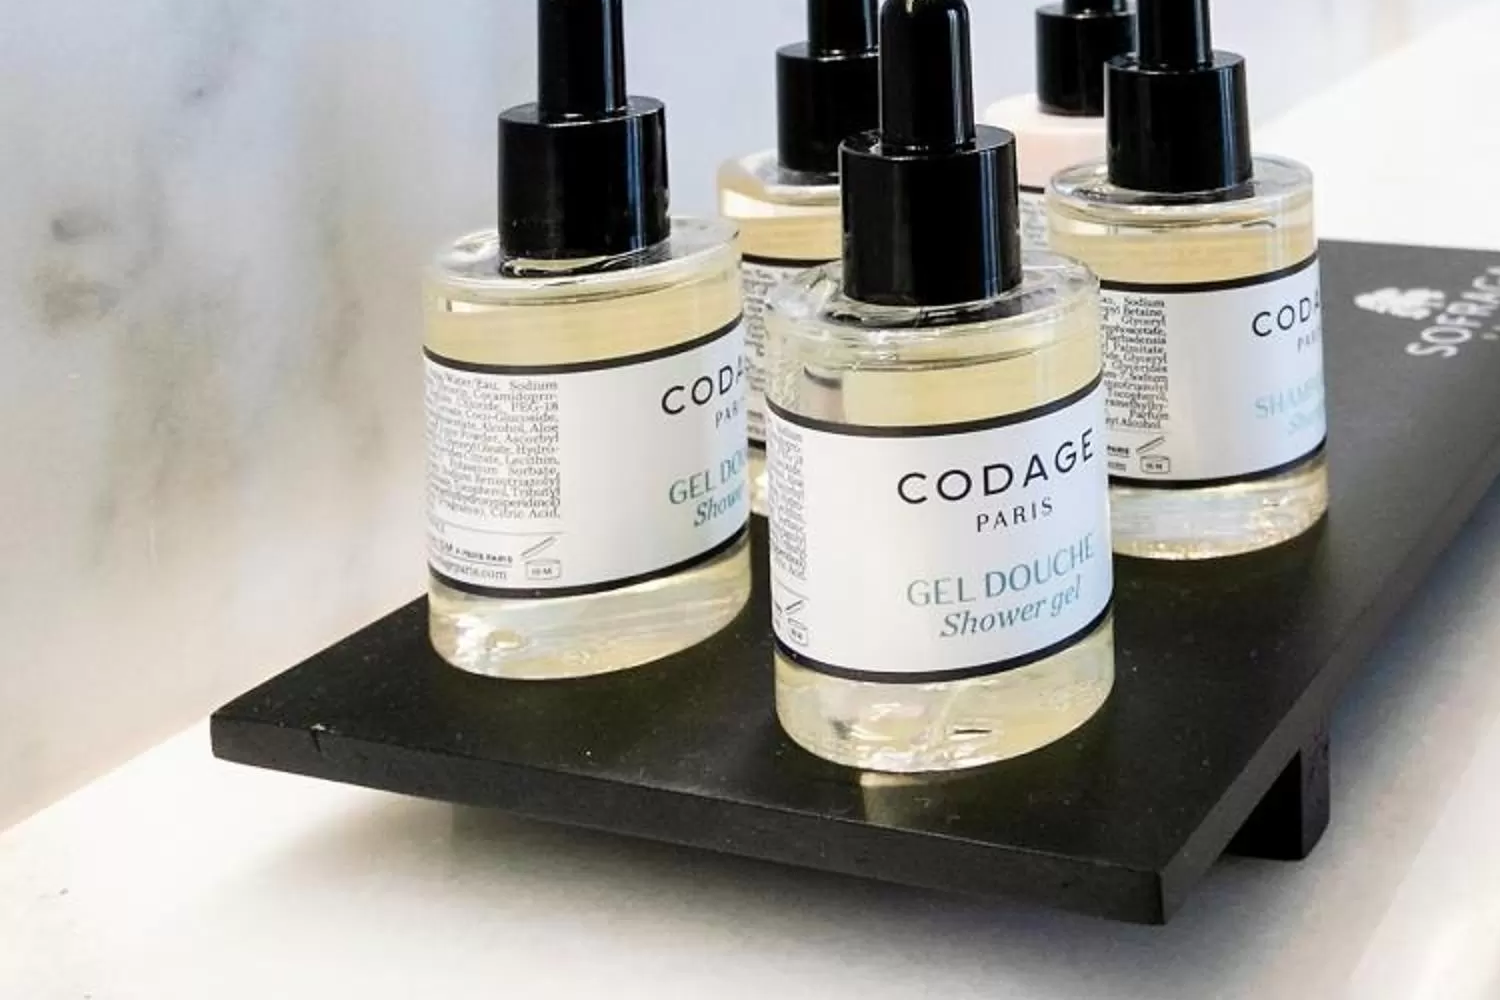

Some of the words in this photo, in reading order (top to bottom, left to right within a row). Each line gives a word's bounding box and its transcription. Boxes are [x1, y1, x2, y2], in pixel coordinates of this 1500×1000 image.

[669, 469, 717, 505] GEL
[897, 428, 1095, 504] CODAGE
[976, 497, 1054, 532] PARIS
[907, 577, 976, 607] GEL
[985, 533, 1095, 599] DOUCHE
[940, 599, 1046, 639] Shower
[1051, 575, 1081, 618] gel
